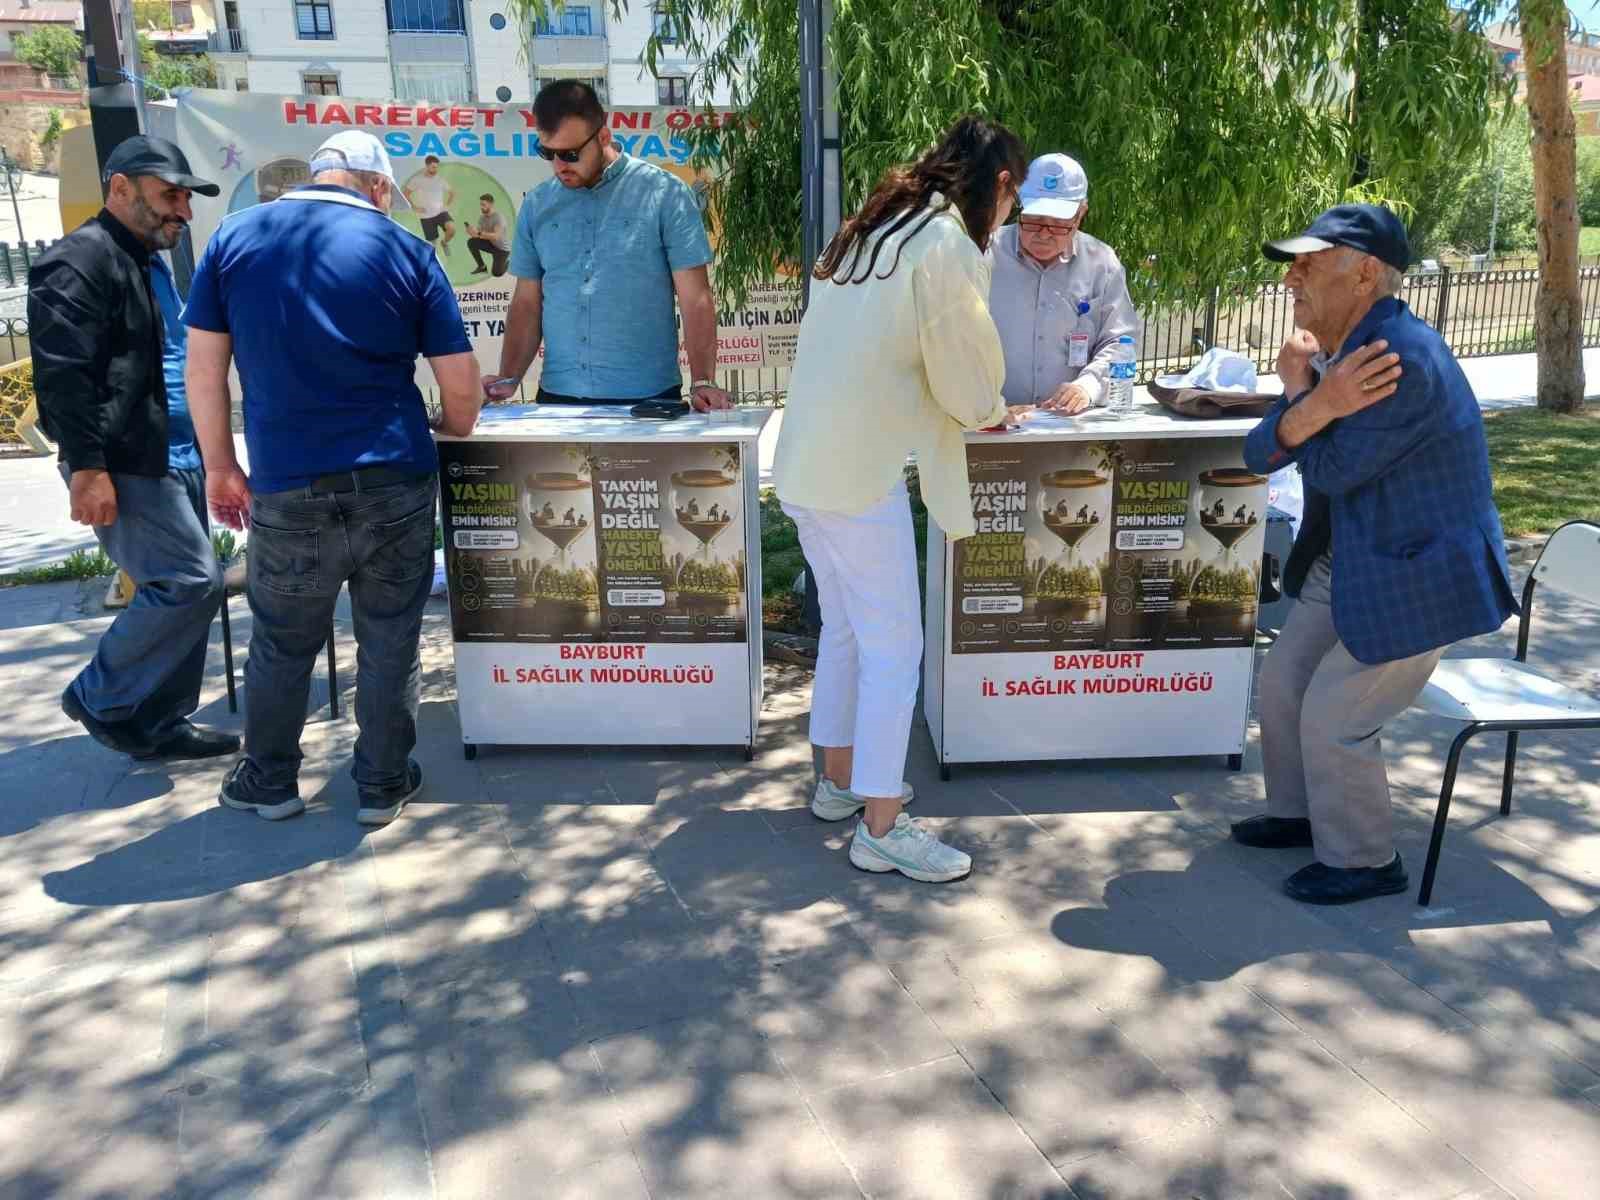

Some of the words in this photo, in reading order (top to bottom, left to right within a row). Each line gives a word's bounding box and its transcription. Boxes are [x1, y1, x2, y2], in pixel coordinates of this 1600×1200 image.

[284, 102, 503, 127] HAREKET
[486, 320, 505, 337] YA
[600, 477, 658, 492] TAKVİM
[1120, 480, 1188, 501] YAŞINI
[601, 494, 659, 514] YAŞIN
[452, 514, 479, 526] EMİN
[481, 514, 517, 527] MİSİN?
[601, 510, 659, 529] DEĞİL
[976, 513, 1024, 532] EĞİL
[1116, 513, 1145, 526] EMİN
[1147, 512, 1185, 526] MİSİN?
[560, 645, 646, 660] BAYBURT
[1053, 652, 1145, 670] BAYBURT
[493, 664, 510, 683] İL
[516, 665, 584, 683] SAĞLIK
[590, 664, 714, 684] MÜDÜRLÜĞÜ
[982, 677, 999, 696] İL
[1006, 676, 1076, 695] SAĞLIK
[1083, 672, 1213, 694] MÜDÜRLÜĞÜ
